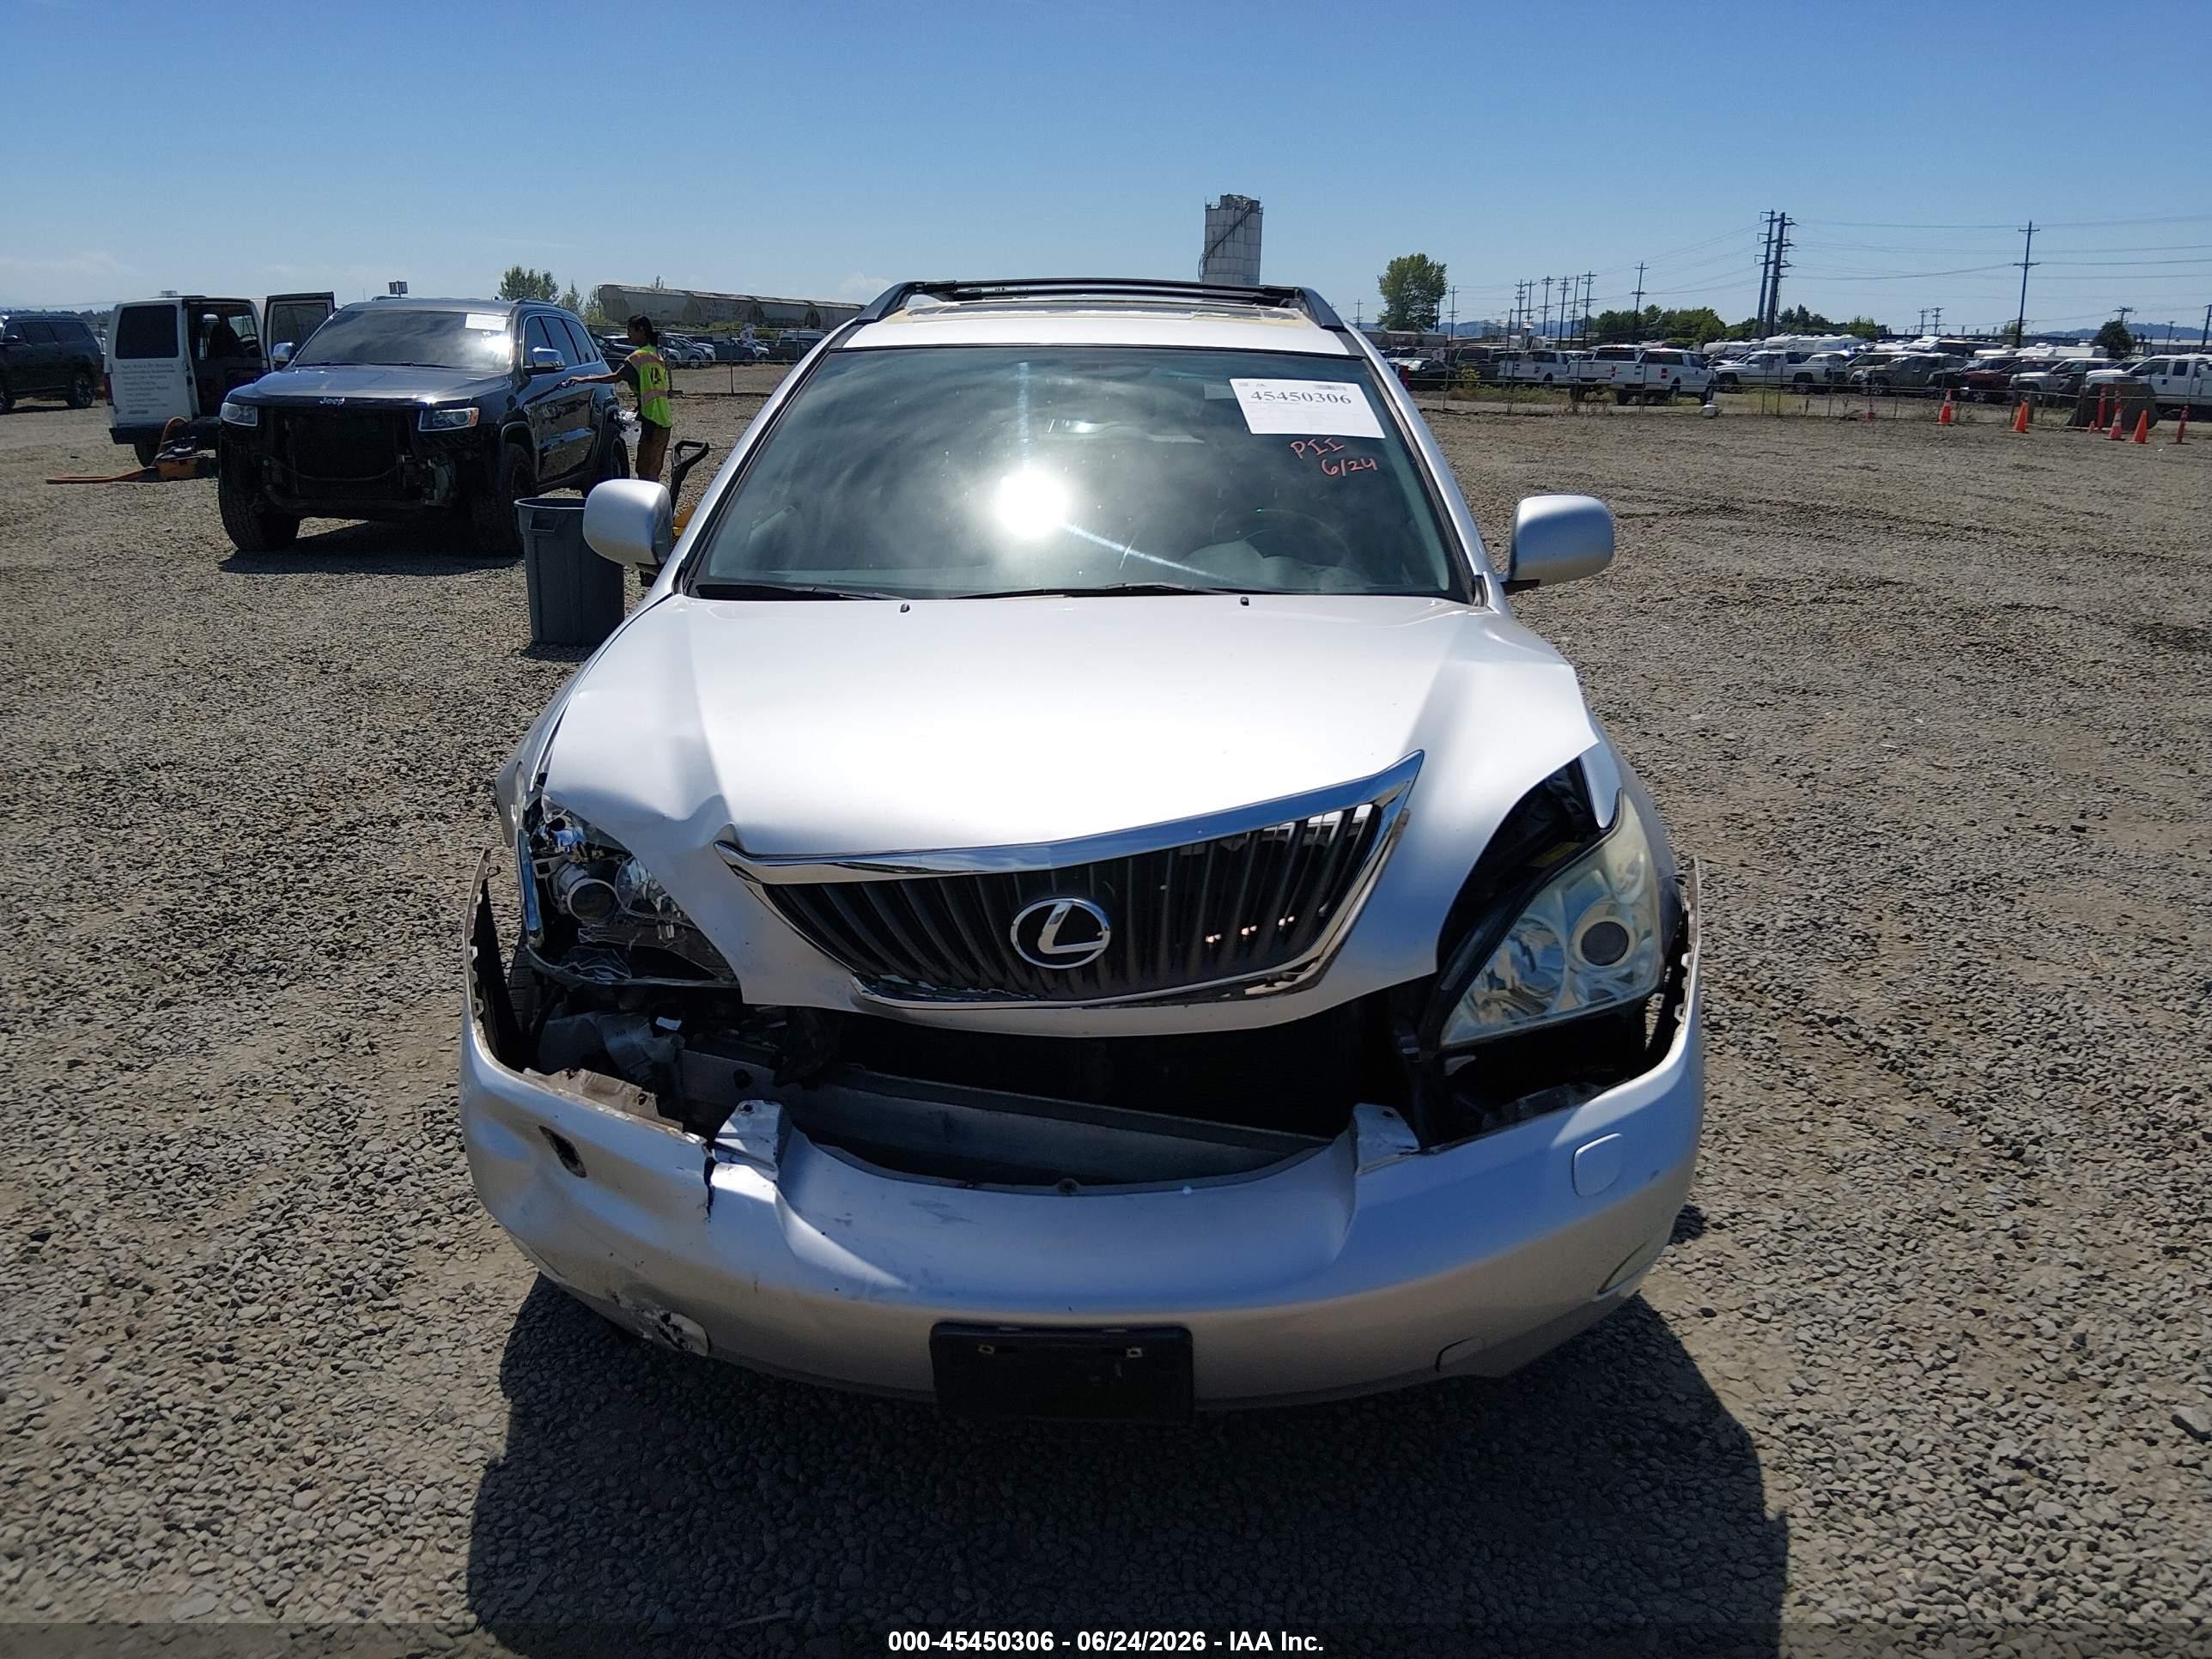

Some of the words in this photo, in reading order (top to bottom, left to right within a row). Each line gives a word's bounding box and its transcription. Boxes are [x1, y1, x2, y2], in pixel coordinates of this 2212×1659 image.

[319, 397, 345, 406] Jeep
[1251, 390, 1352, 405] 45450306
[1321, 457, 1378, 477] 6/24
